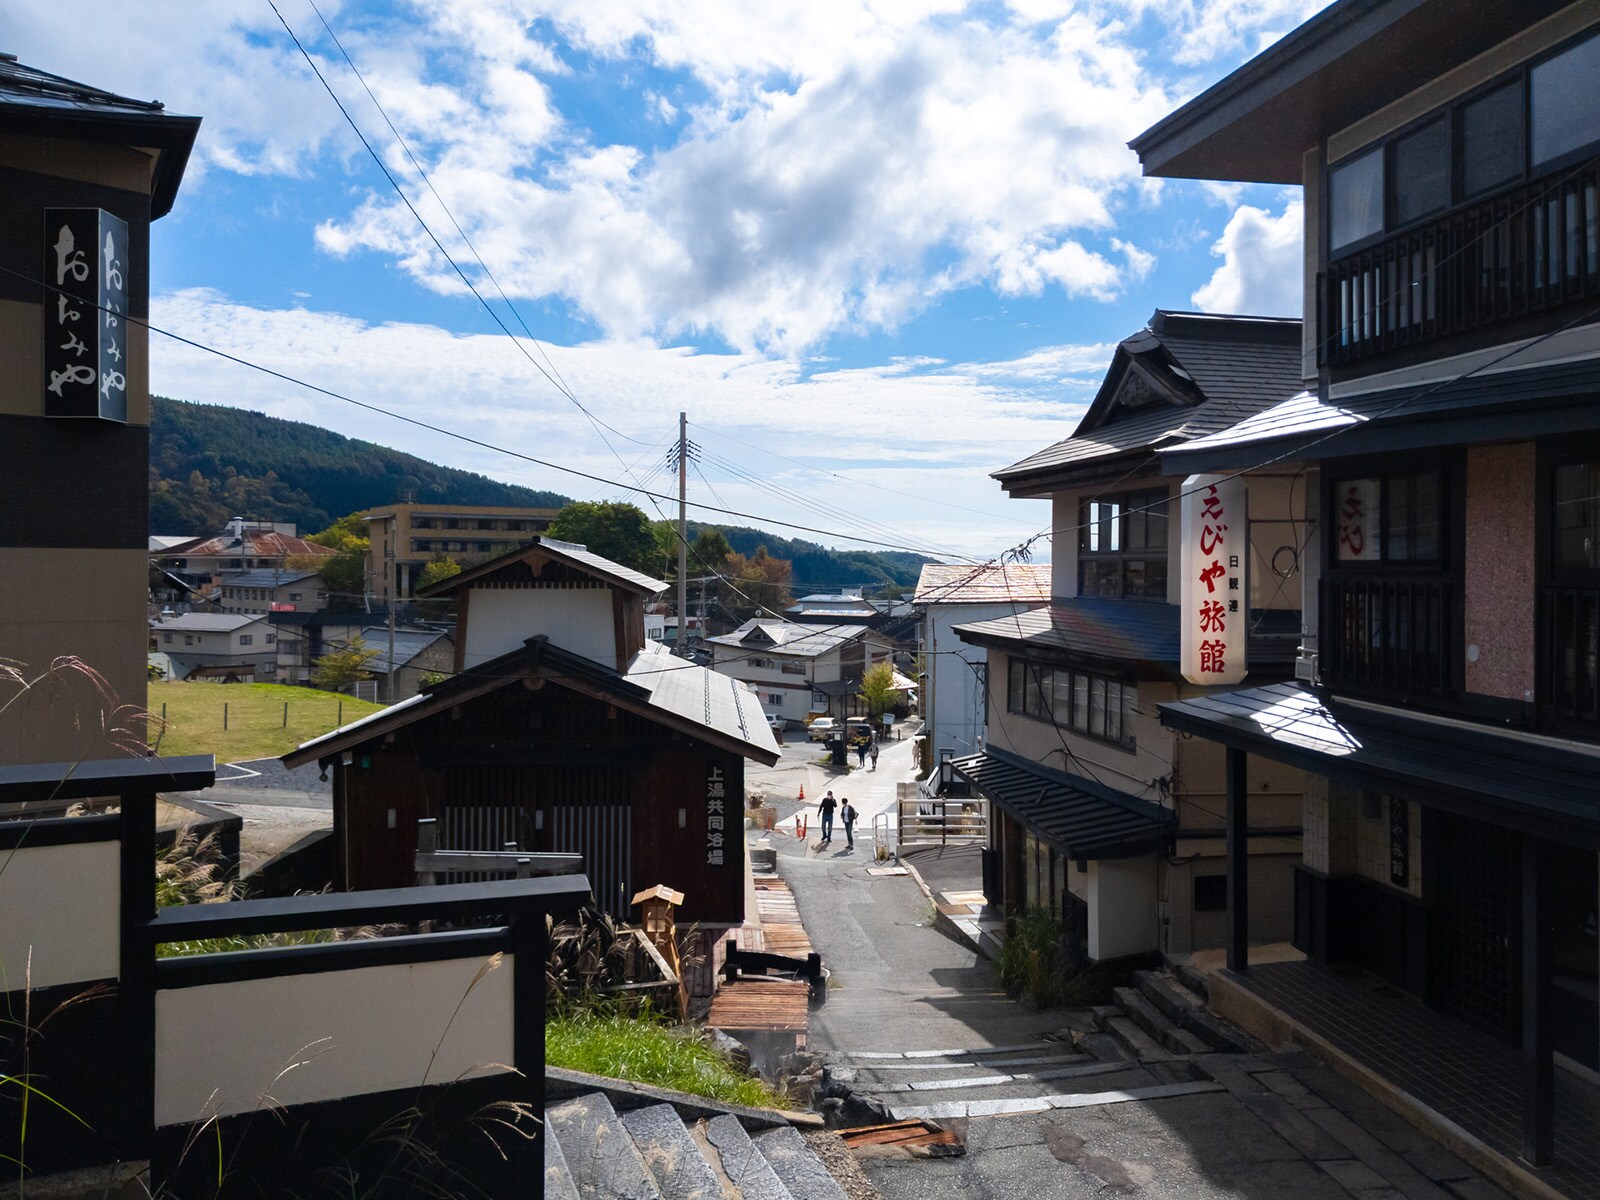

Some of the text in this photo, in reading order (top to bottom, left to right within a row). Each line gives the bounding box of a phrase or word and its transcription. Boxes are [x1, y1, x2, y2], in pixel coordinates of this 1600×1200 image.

[1199, 484, 1228, 673] えびや旅館
[1229, 555, 1239, 612] 日観連
[707, 766, 725, 865] 上湯共同浴場
